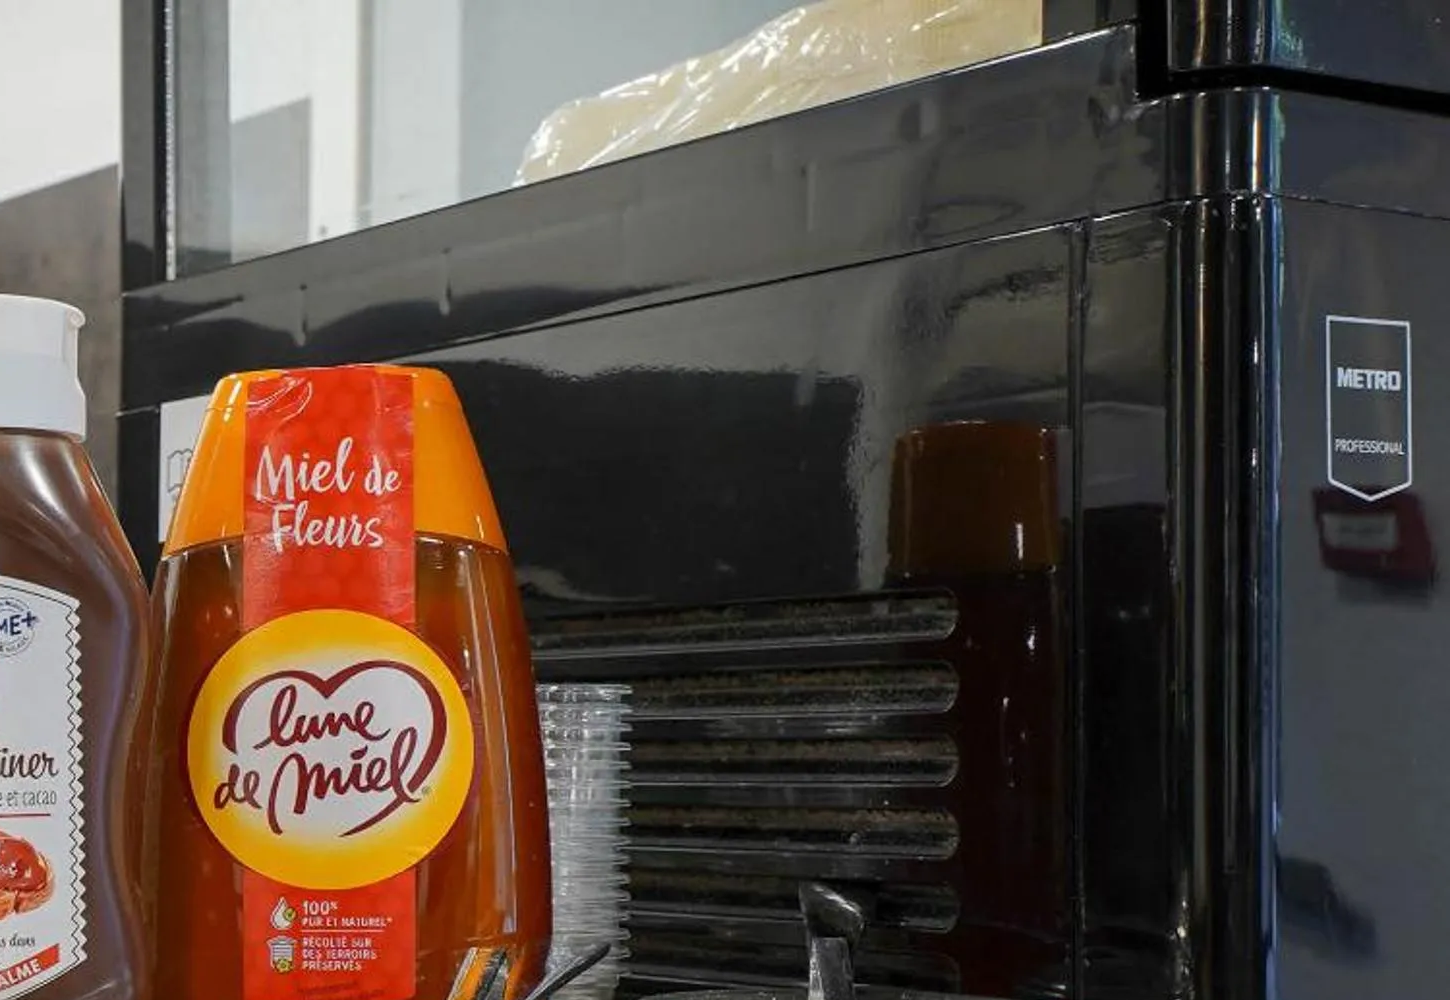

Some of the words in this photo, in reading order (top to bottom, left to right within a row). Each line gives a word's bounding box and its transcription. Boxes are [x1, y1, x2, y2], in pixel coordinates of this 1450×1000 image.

[1336, 366, 1402, 392] METRO
[1334, 438, 1405, 455] PROFESSIONAL
[255, 436, 355, 503] Miel
[363, 454, 401, 496] de
[271, 500, 384, 552] Fleurs
[254, 684, 391, 750] lune
[6, 790, 19, 807] et
[22, 788, 58, 806] cacao
[213, 763, 263, 810] de
[302, 900, 339, 916] 100%
[302, 917, 324, 927] PUR
[326, 917, 338, 927] ET
